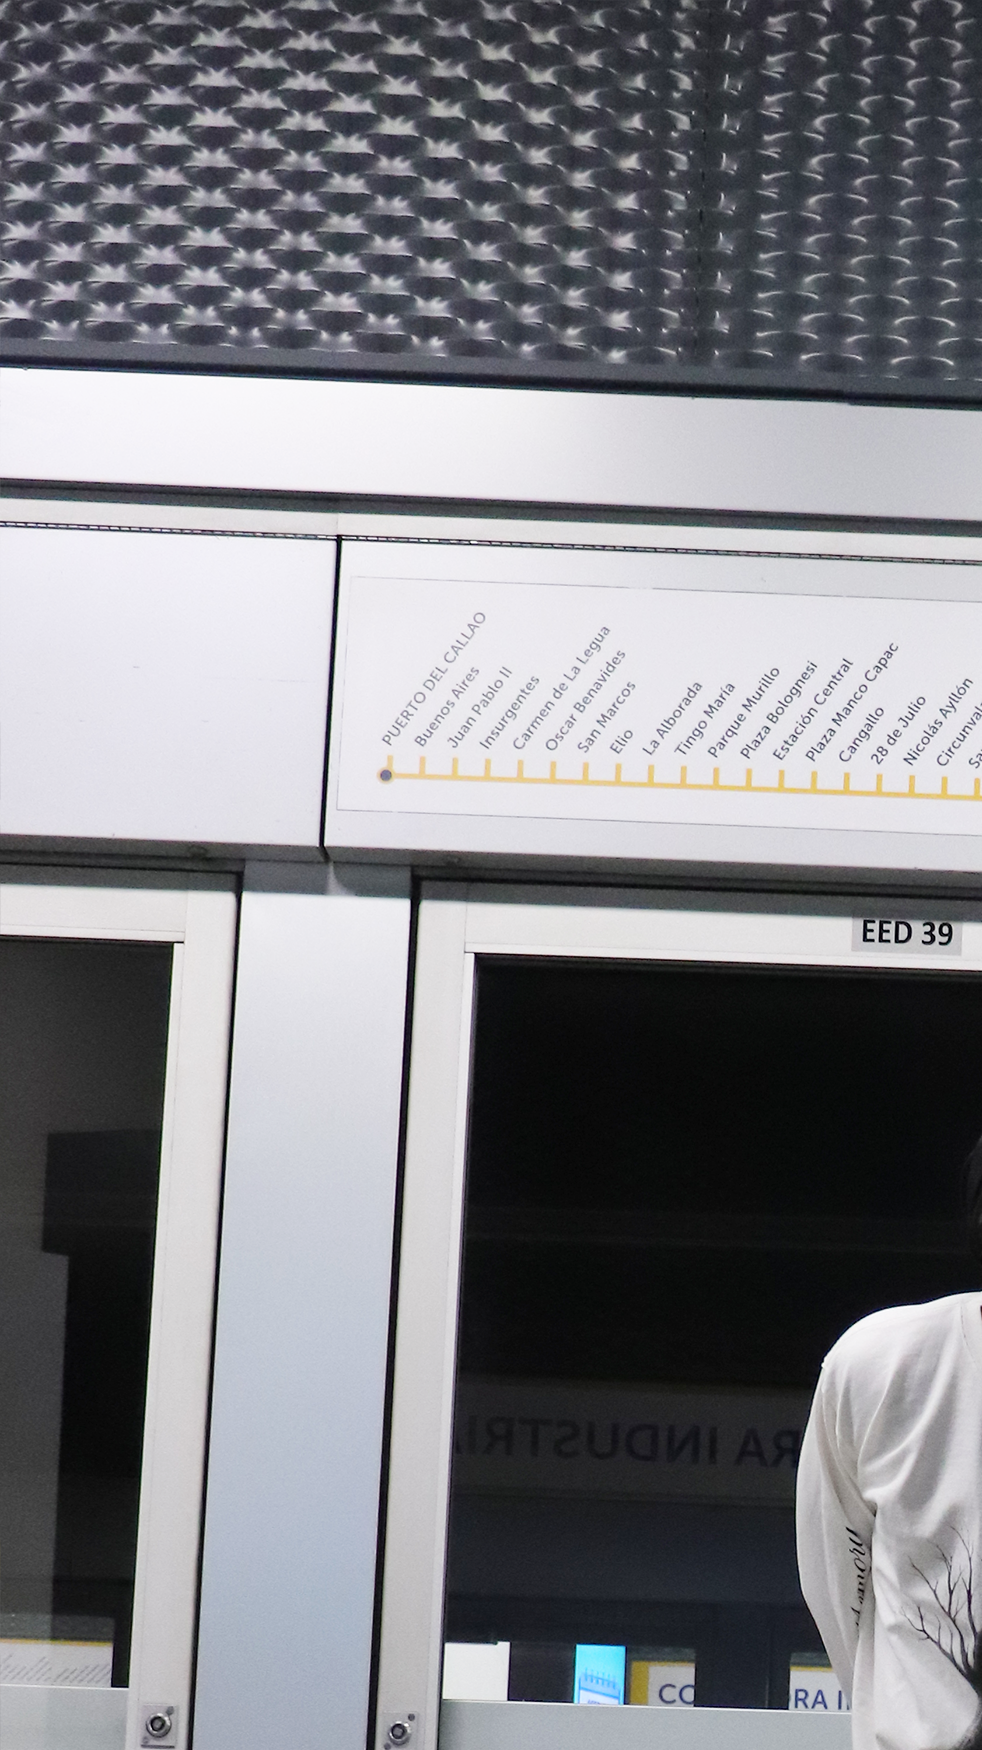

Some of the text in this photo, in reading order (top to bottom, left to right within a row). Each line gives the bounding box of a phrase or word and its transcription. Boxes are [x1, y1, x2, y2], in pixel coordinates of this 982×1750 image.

[381, 612, 486, 746] PUERTO DEL CALLAO
[414, 667, 479, 747] Buenos Aires
[447, 666, 512, 748] Juan Pablo II
[479, 676, 540, 750] Insurgentes
[513, 626, 611, 750] Carmen de La Legua
[545, 650, 626, 751] Oscar Benavides
[577, 681, 636, 753] San Marcos
[642, 682, 703, 756] La Alborada
[674, 683, 736, 755] Tingo María
[707, 668, 780, 758] Parque Murillo
[740, 660, 818, 760] Plaza Bolognesi
[772, 658, 854, 761] Estación Central
[805, 642, 899, 762] Plaza Manco Capac
[609, 730, 633, 754] Elio
[839, 707, 884, 762] Cangallo
[870, 696, 926, 765] 28 de Julio
[902, 678, 974, 766] Nicolás Ayllón
[862, 919, 953, 946] EED 39
